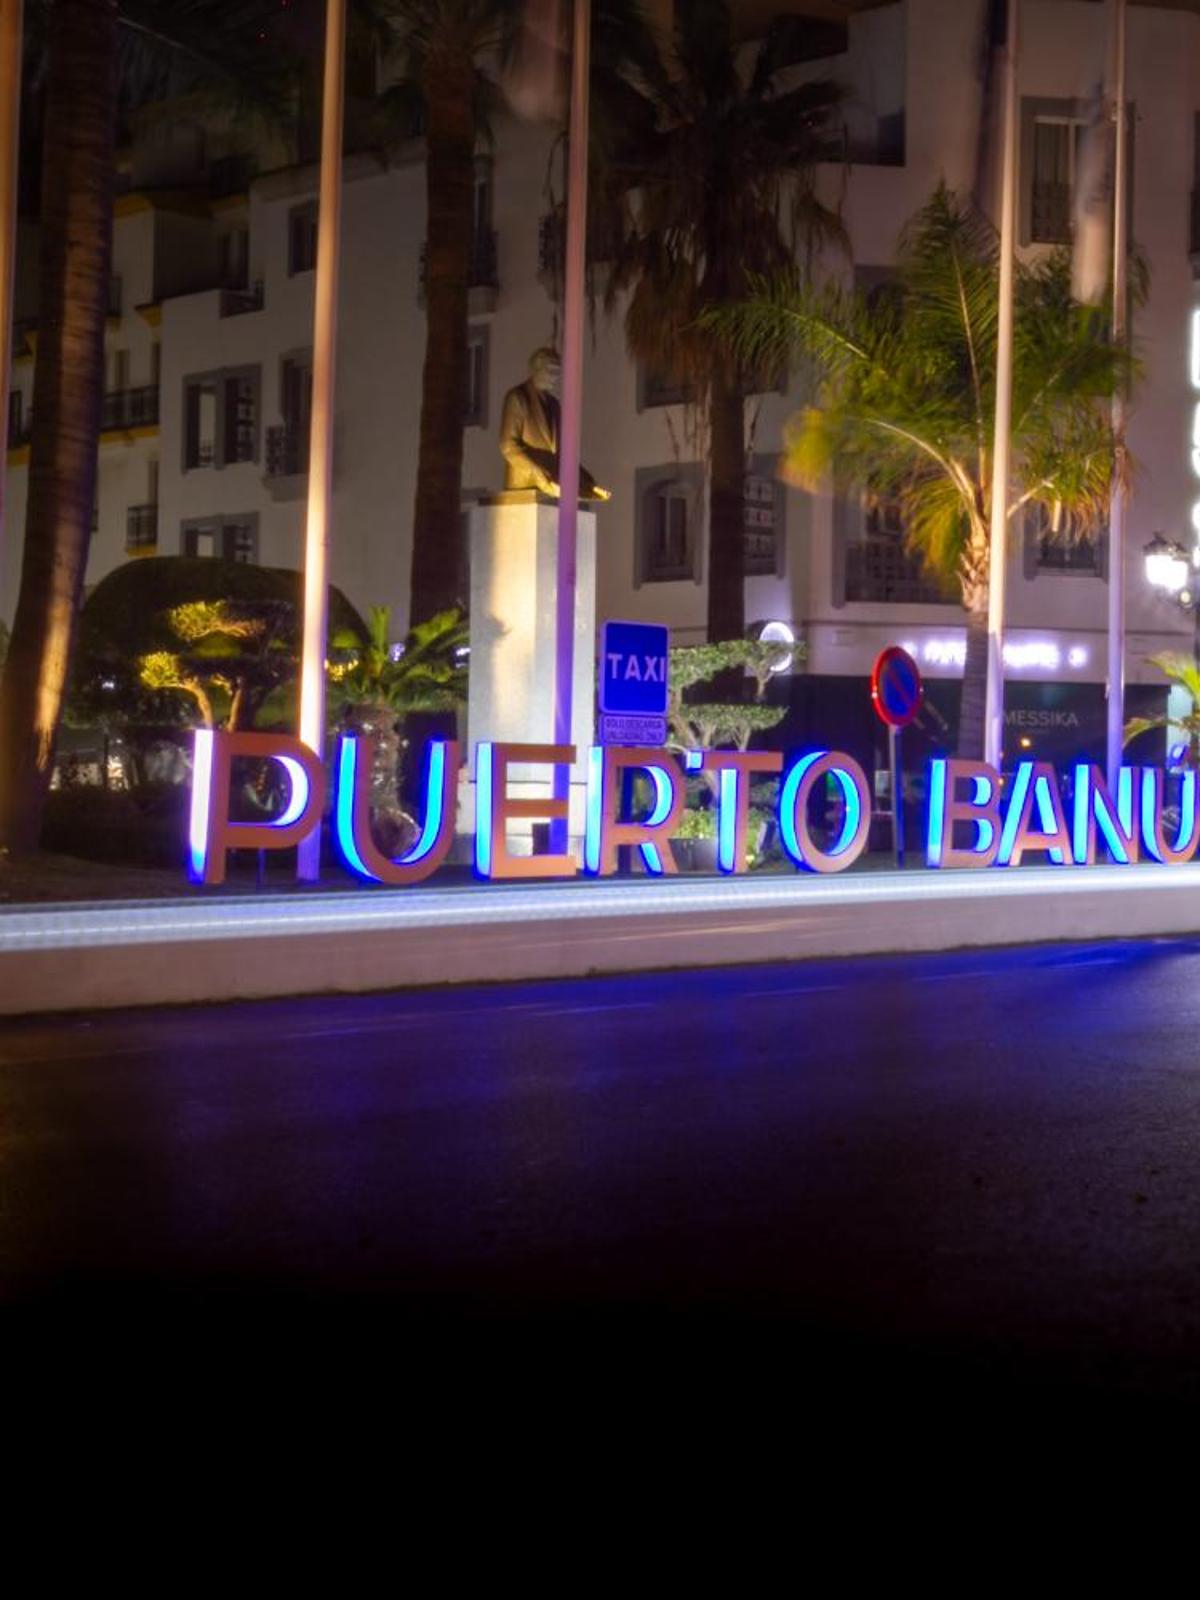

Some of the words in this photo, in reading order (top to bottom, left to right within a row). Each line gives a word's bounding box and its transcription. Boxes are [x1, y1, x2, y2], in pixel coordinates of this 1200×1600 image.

[608, 653, 665, 682] TAXI
[1005, 710, 1079, 727] MESSIKA
[189, 729, 870, 884] PUERTO
